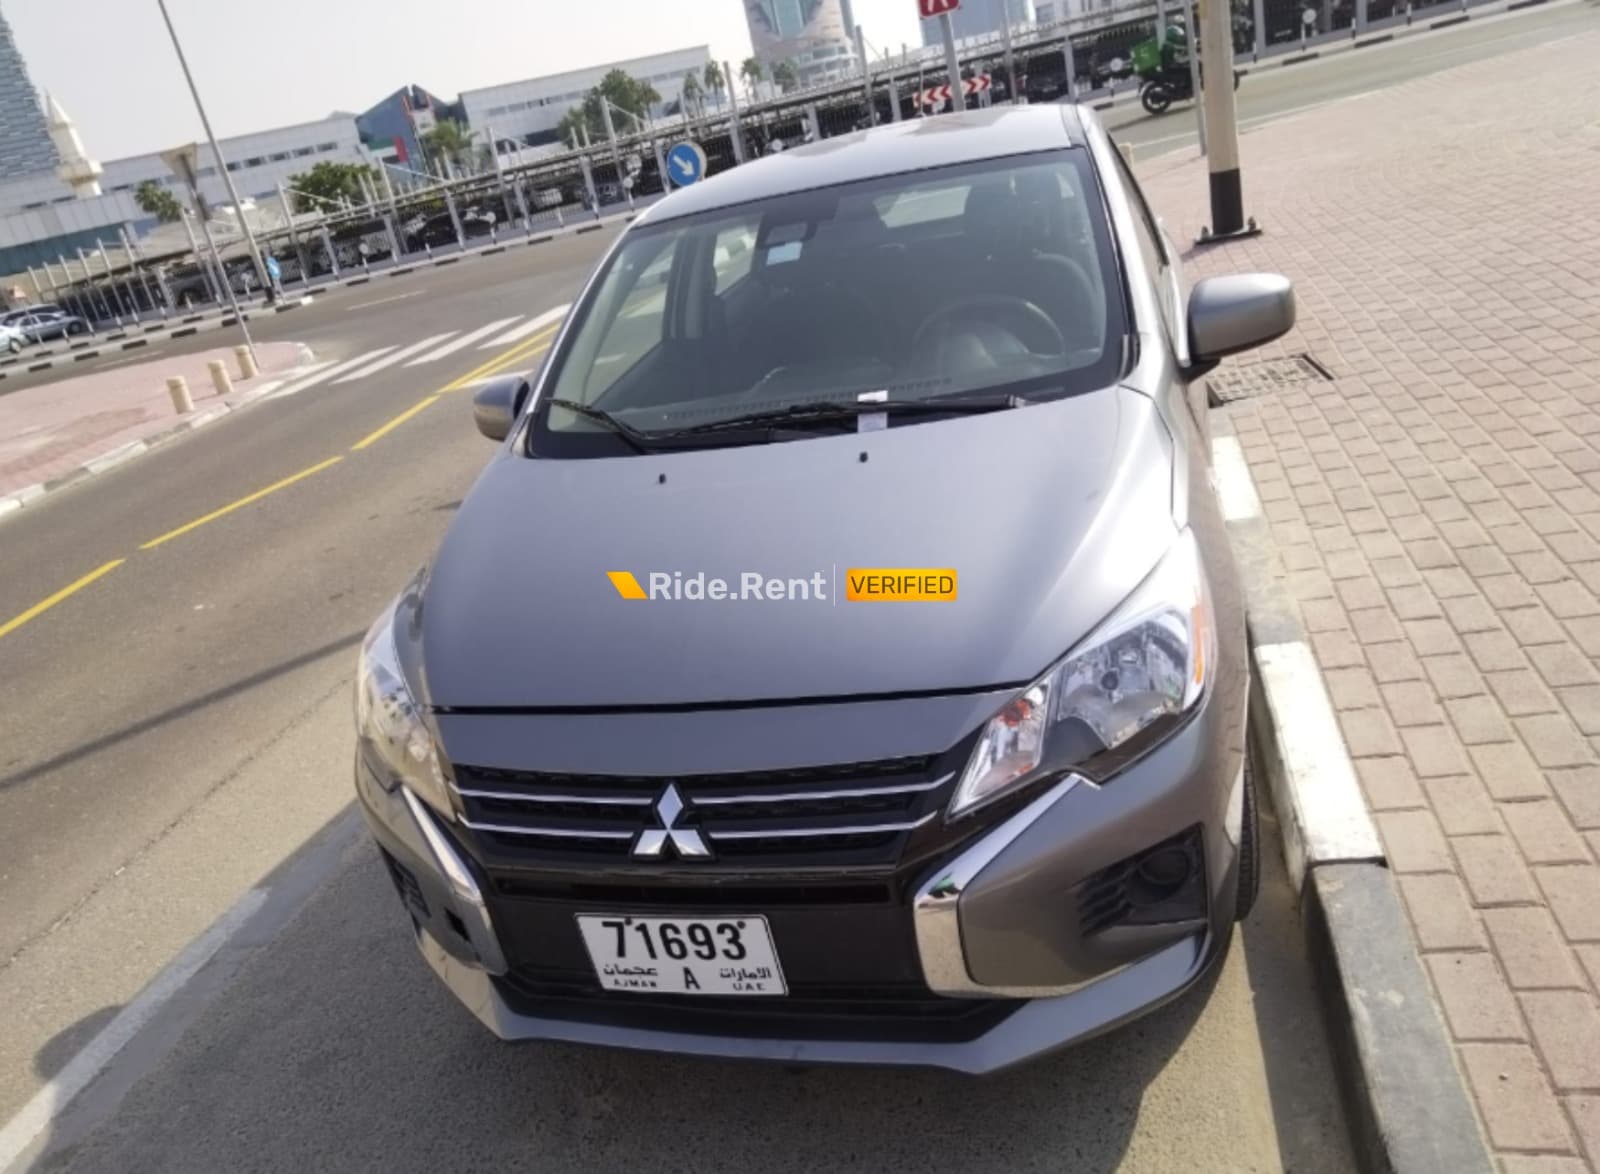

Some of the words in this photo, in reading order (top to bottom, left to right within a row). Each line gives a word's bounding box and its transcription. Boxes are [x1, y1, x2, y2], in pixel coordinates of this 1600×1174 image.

[602, 920, 747, 961] 71693
[603, 963, 658, 977] عجمان
[682, 966, 701, 990] A
